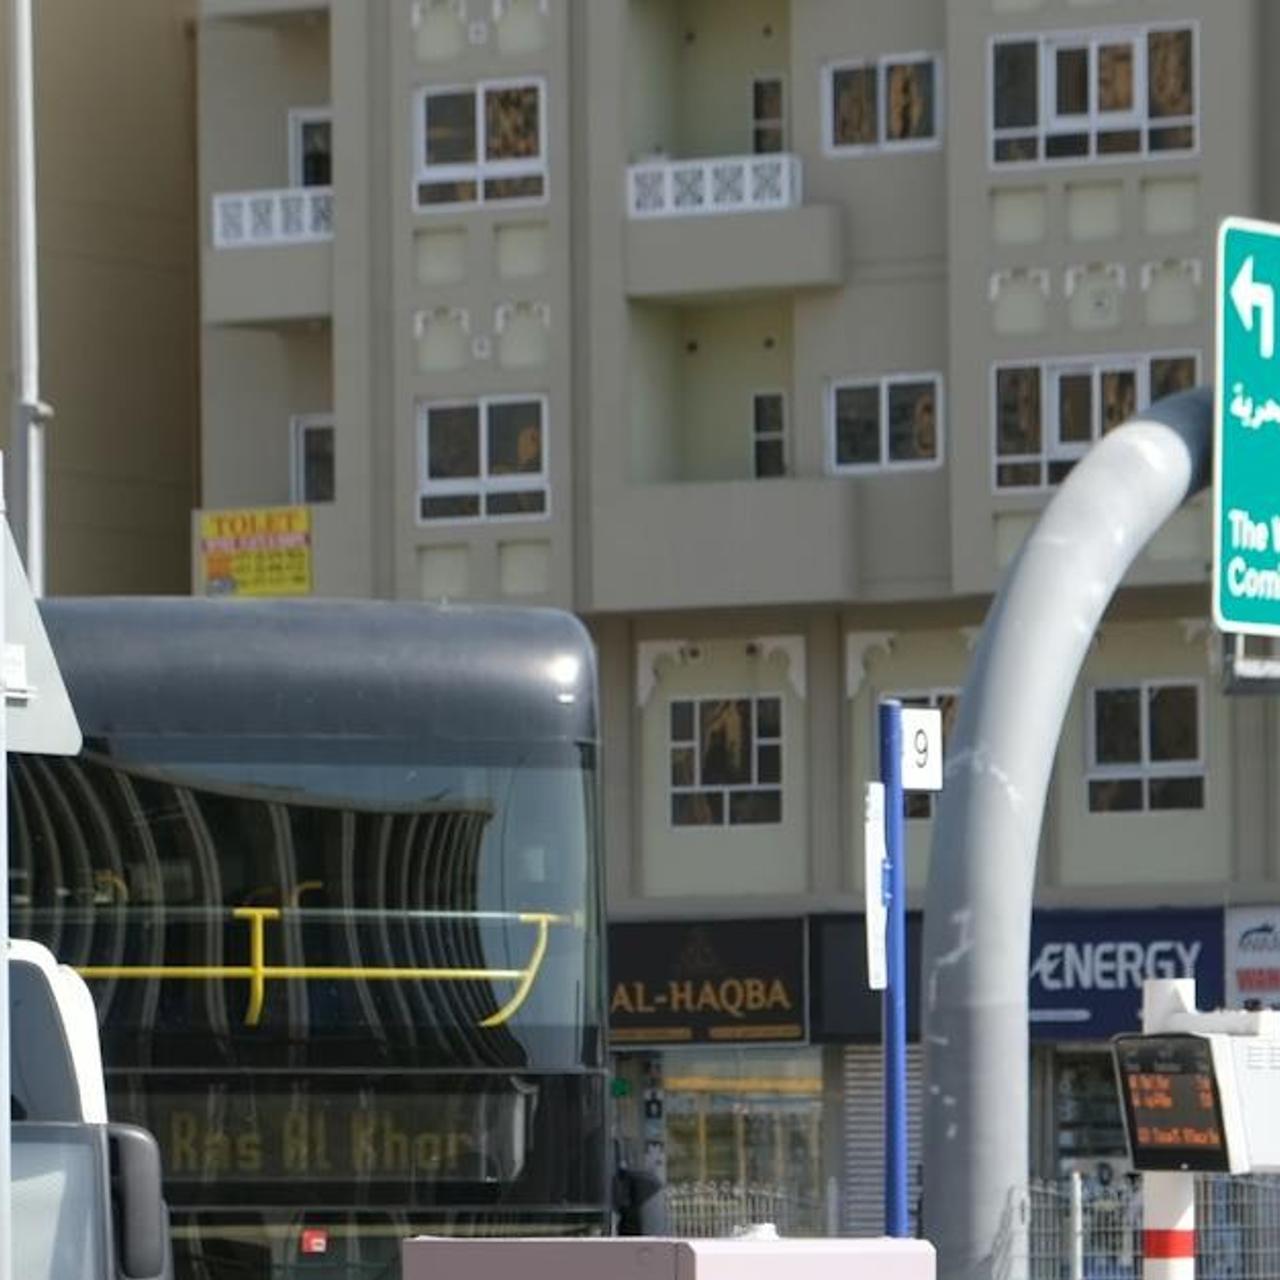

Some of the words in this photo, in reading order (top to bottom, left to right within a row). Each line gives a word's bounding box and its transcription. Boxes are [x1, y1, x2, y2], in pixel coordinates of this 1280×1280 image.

[1228, 508, 1269, 552] The
[914, 728, 929, 769] 9
[1032, 940, 1203, 990] ENERGY
[611, 976, 792, 1018] AL-HAQBA
[169, 1110, 264, 1172] Ras
[351, 1110, 474, 1172] Khor
